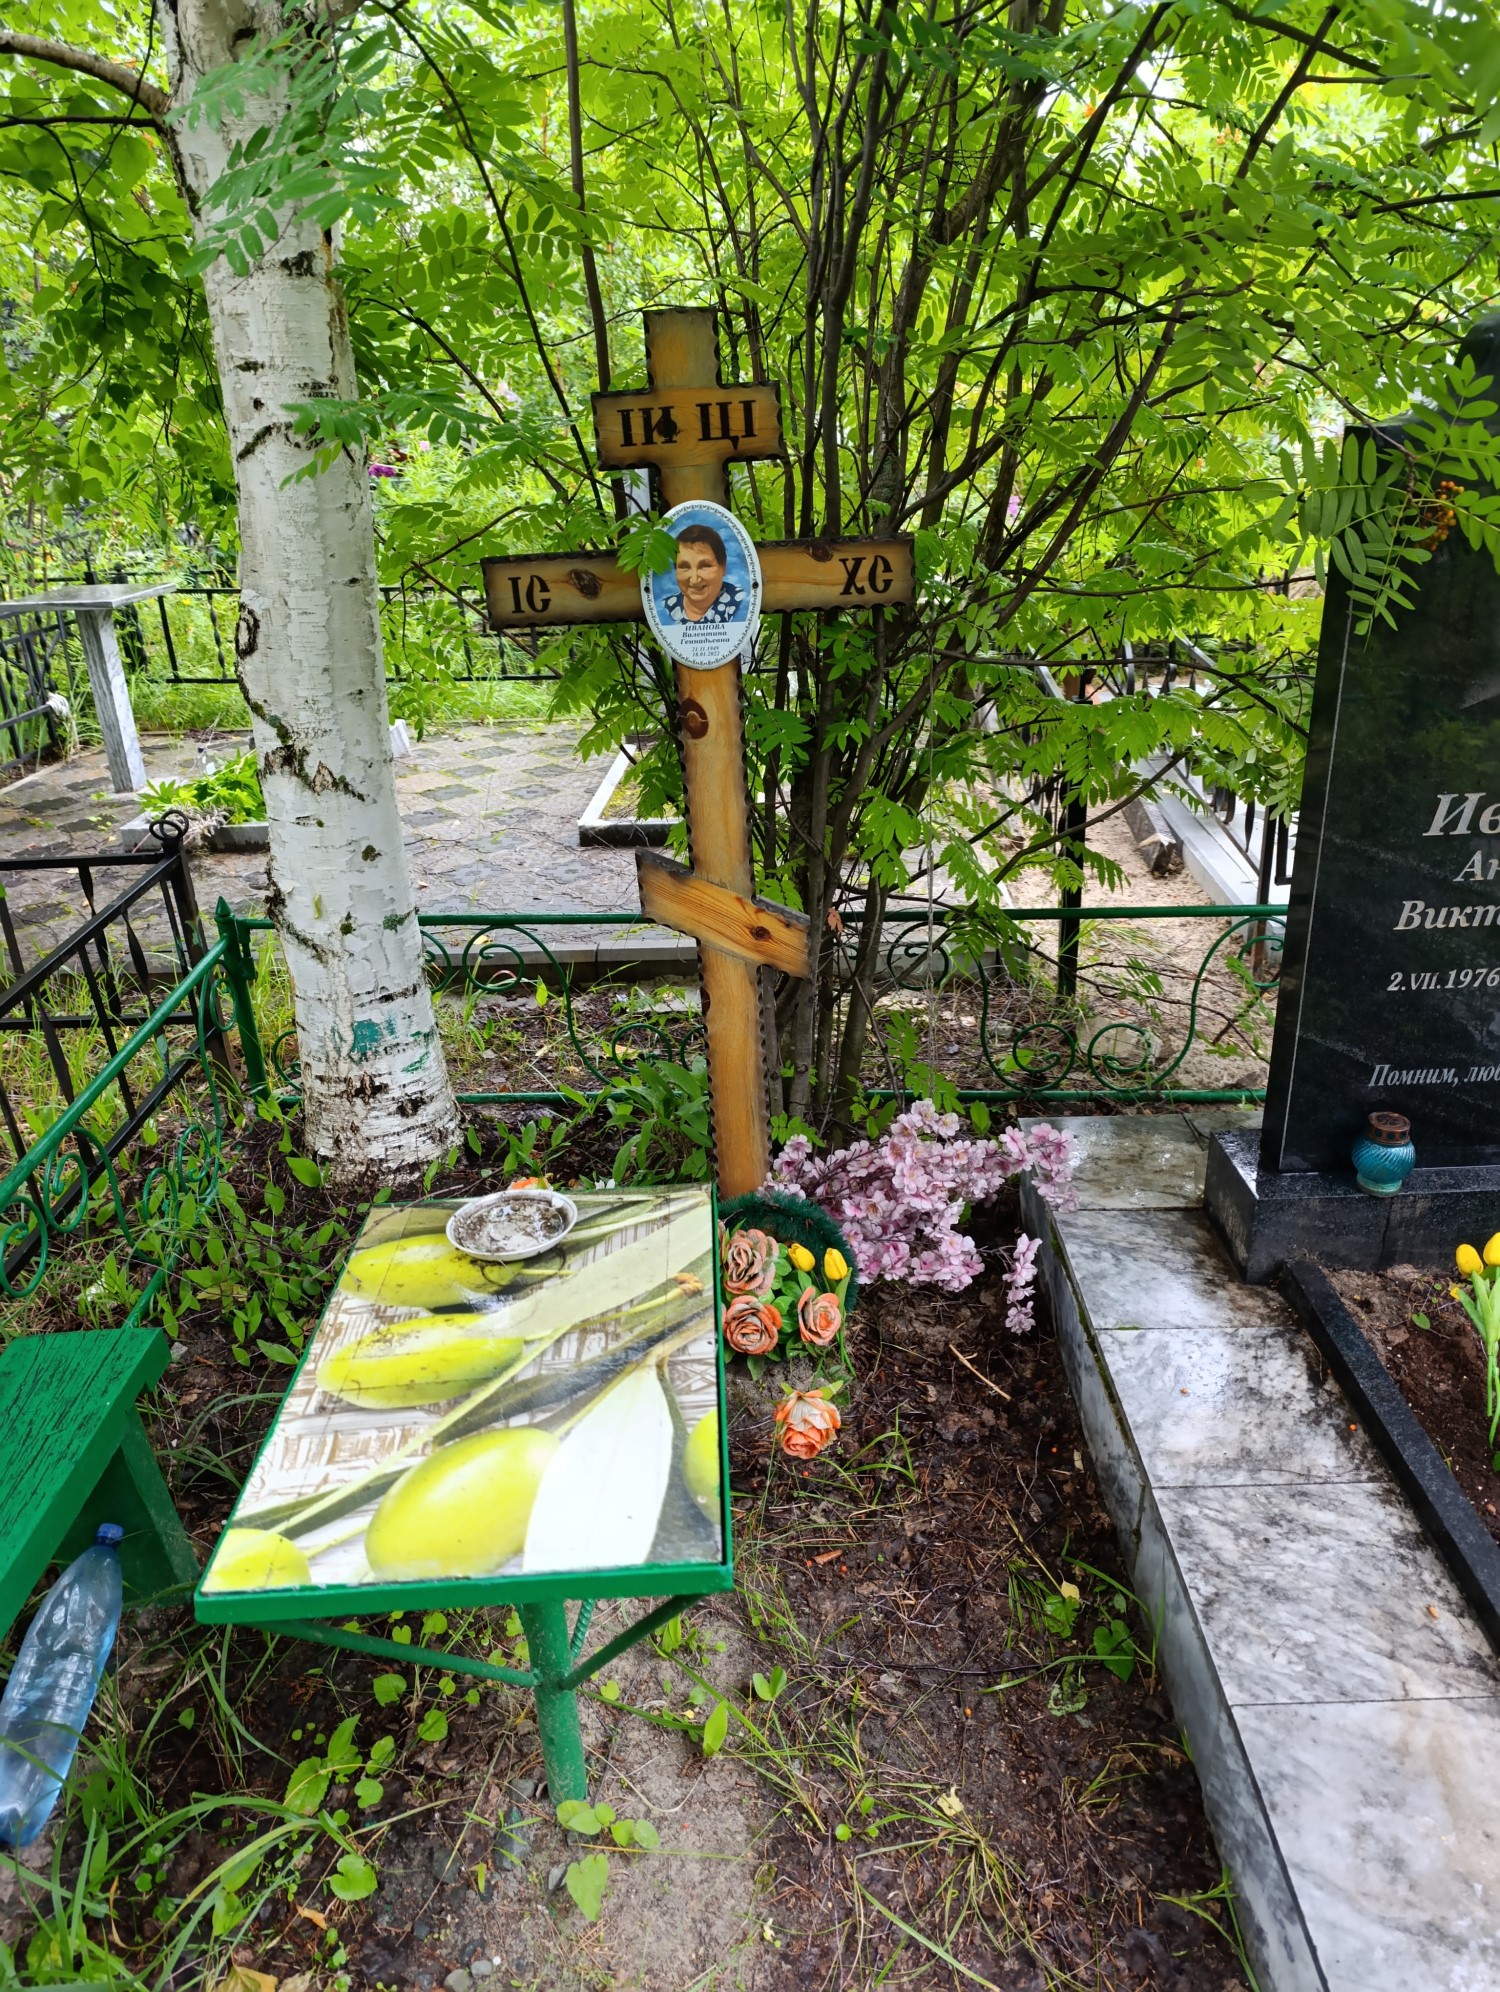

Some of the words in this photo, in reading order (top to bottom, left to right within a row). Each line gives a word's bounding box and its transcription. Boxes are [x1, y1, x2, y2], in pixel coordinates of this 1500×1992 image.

[685, 623, 725, 631] ИВАНОВА
[680, 637, 730, 645] Геннадьевна
[1367, 1064, 1459, 1088] Помним,
